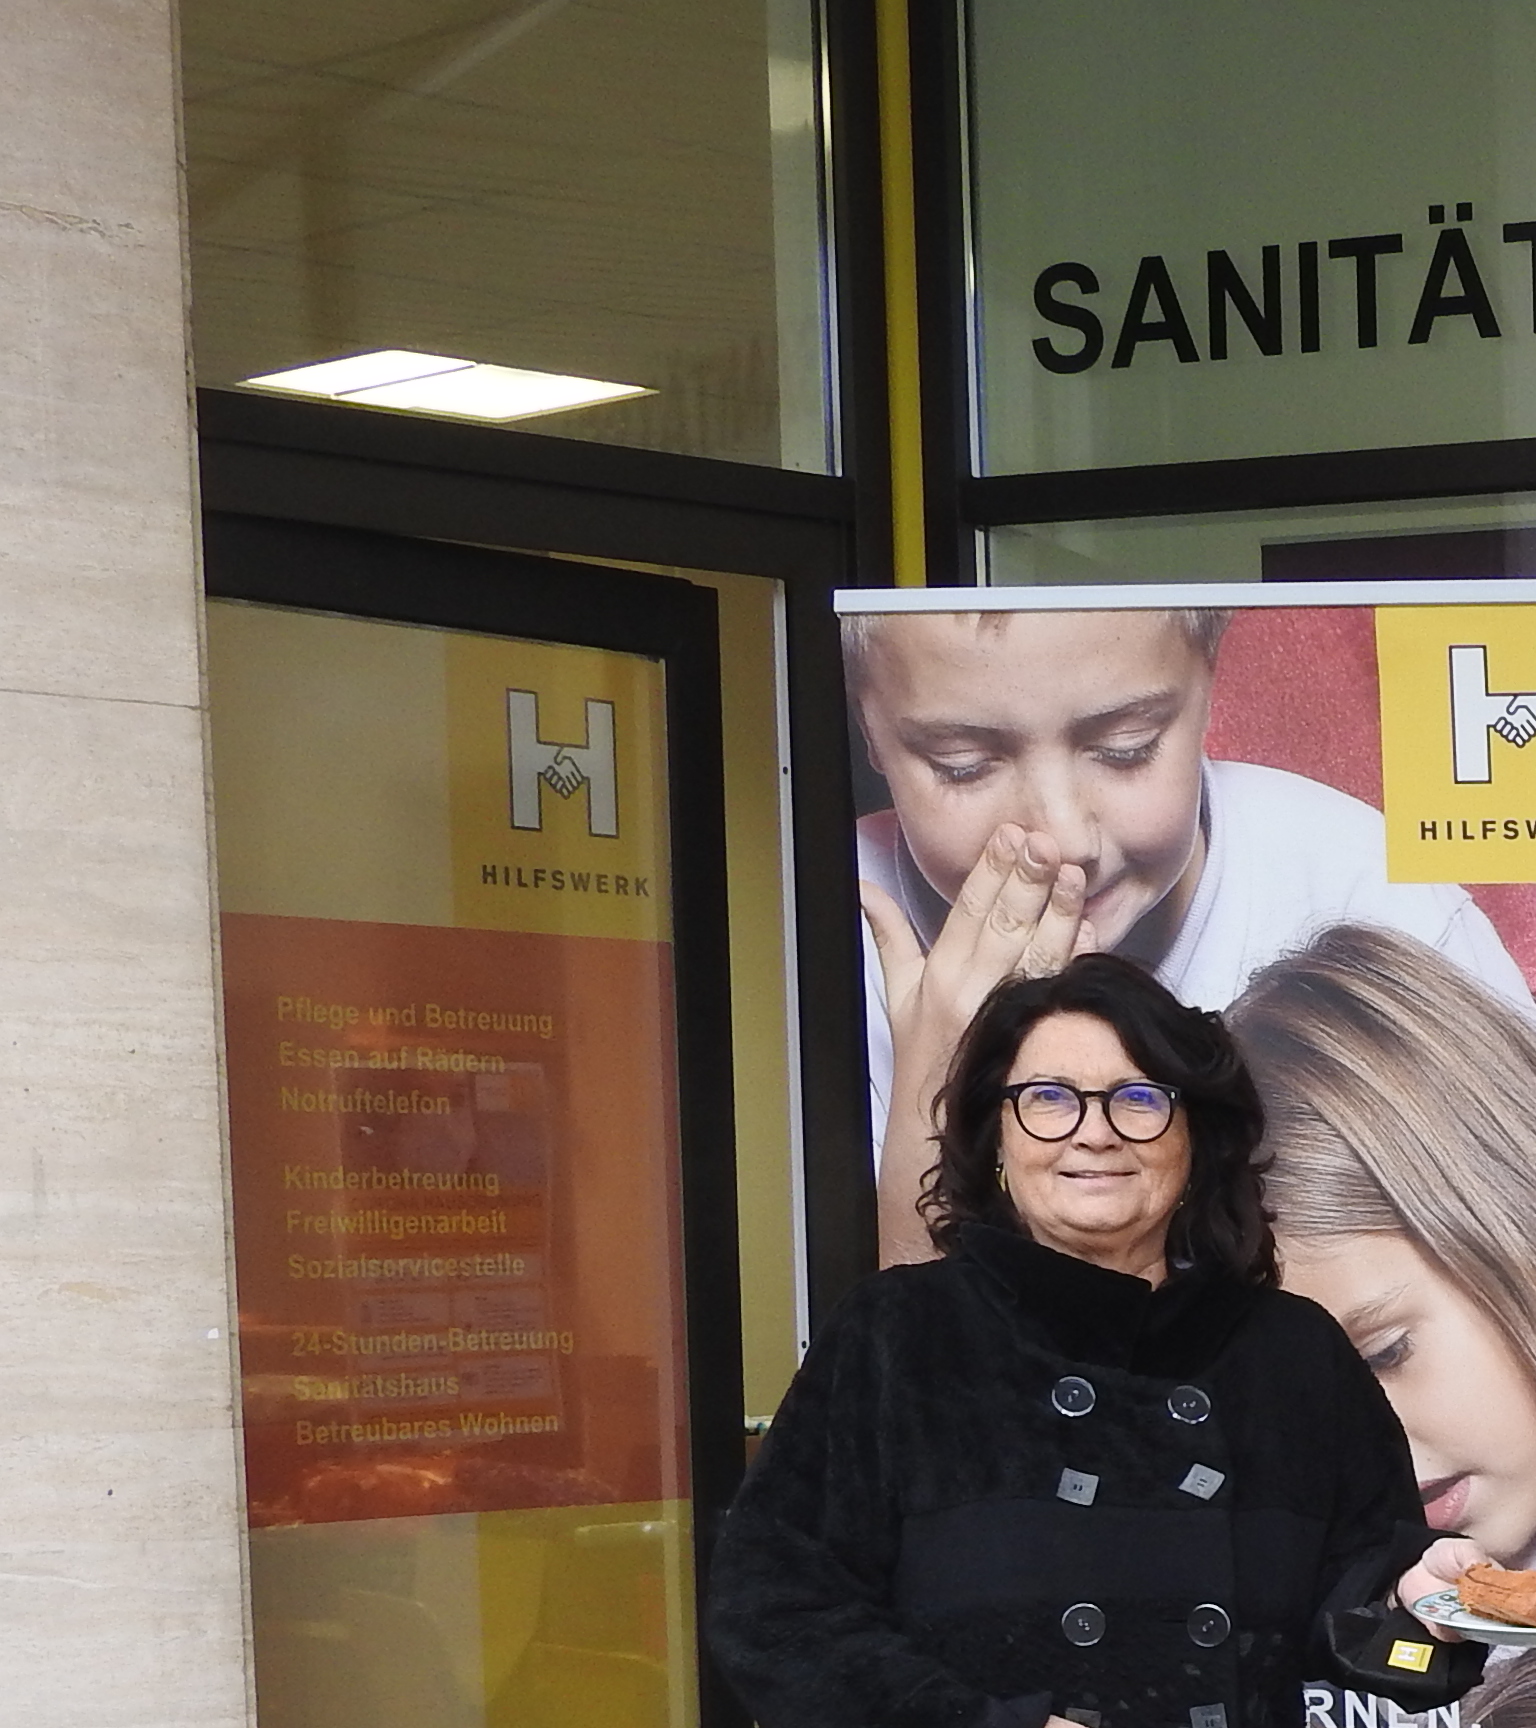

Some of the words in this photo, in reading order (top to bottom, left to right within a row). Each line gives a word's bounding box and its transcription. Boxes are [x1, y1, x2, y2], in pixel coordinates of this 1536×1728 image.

[482, 864, 649, 897] HILFSWERK
[277, 996, 358, 1030] Pflege
[369, 1004, 416, 1026] und
[424, 1003, 553, 1039] Betreuung
[278, 1041, 359, 1068] Essen
[367, 1046, 408, 1070] auf
[416, 1047, 506, 1074] Rädern
[280, 1087, 451, 1116] Notruftelefon
[284, 1165, 500, 1196] Kinderbetreuung
[286, 1208, 507, 1240] Freiwilligenarbeit
[288, 1252, 525, 1280] Sozialservicestelle
[290, 1327, 574, 1356] 24-Stunden-Betreuung
[292, 1372, 460, 1401] Sanitätshaus
[296, 1416, 451, 1446] Betreubares
[459, 1411, 560, 1436] Wohnen
